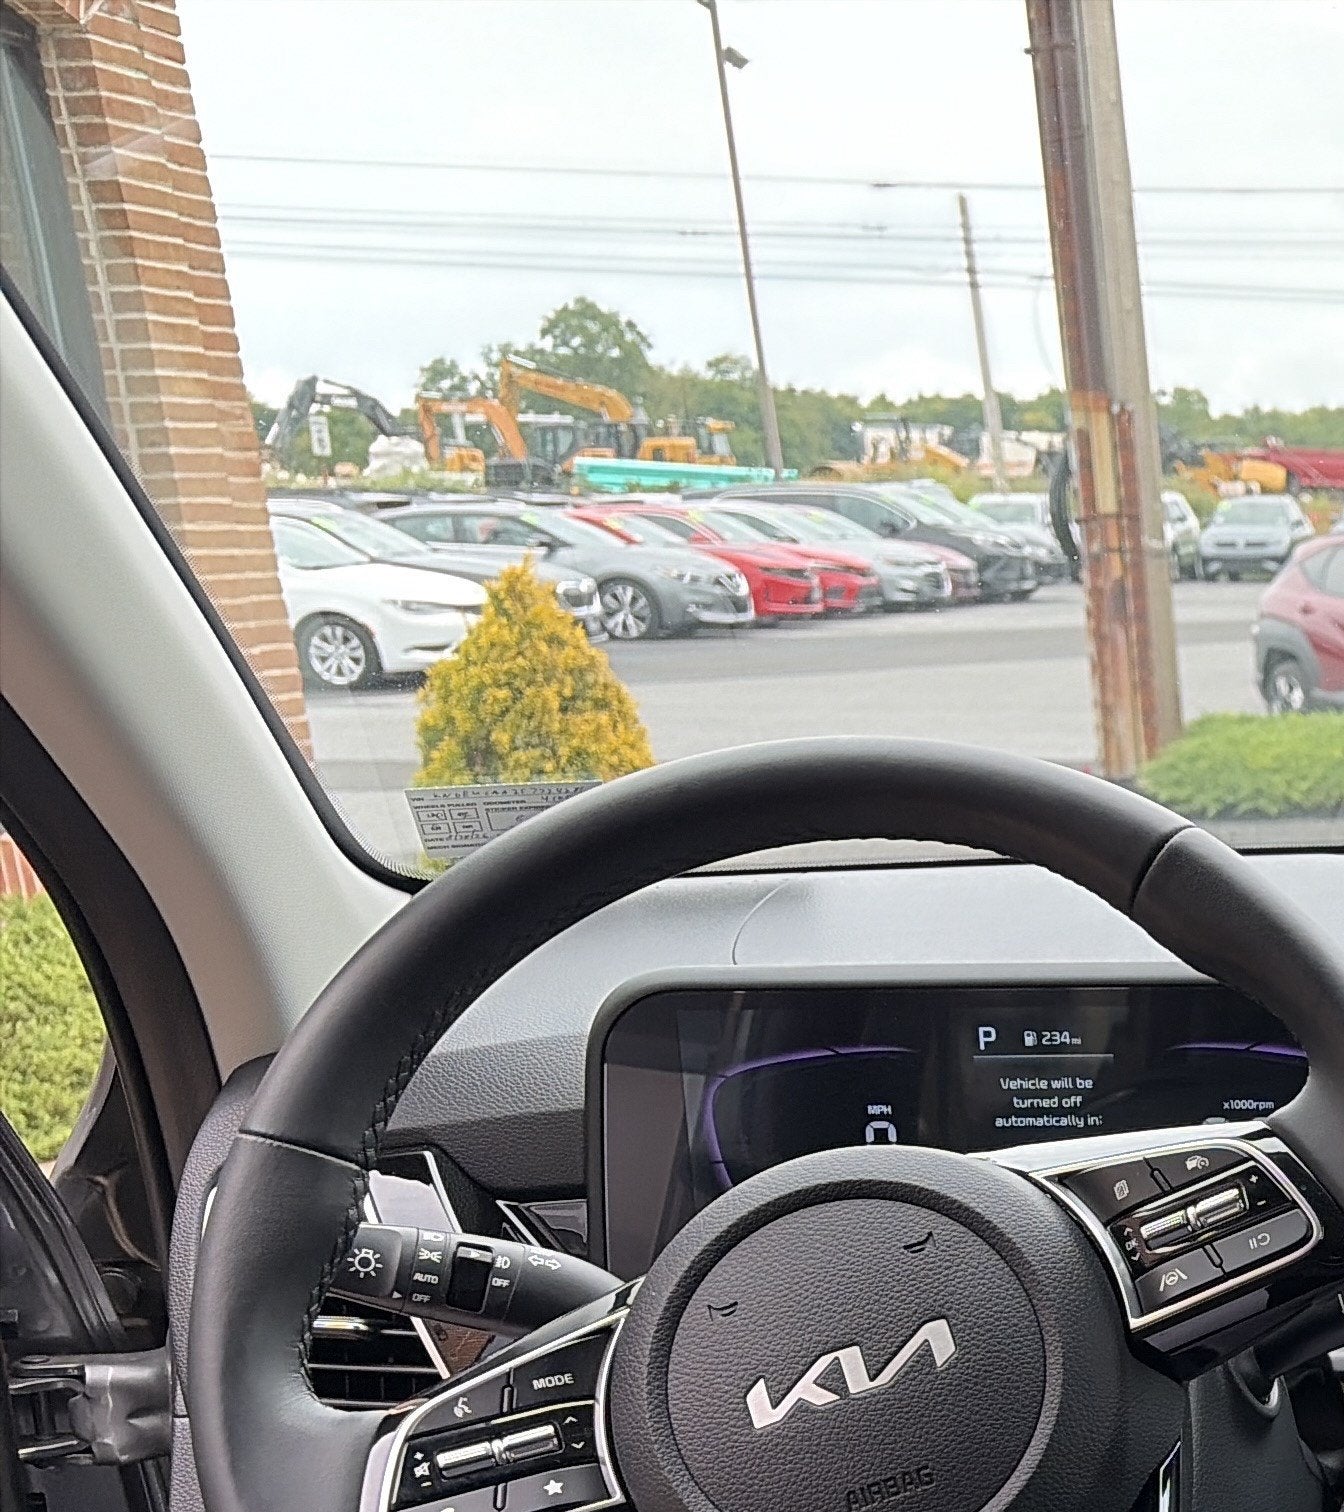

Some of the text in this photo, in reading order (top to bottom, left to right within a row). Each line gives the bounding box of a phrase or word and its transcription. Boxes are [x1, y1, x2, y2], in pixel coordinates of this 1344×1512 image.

[978, 1026, 997, 1051] P
[999, 1077, 1094, 1090] Vehicle will be
[1012, 1095, 1083, 1109] turned off
[1222, 1099, 1275, 1112] x1000rpm
[867, 1104, 893, 1115] MPH
[994, 1114, 1104, 1129] automatically in:
[412, 1272, 439, 1285] AUTO
[491, 1276, 511, 1288] OFF
[411, 1292, 431, 1303] OFF
[745, 1317, 957, 1430] KIA
[532, 1372, 576, 1391] MODE
[846, 1465, 935, 1512] AIRBAG
